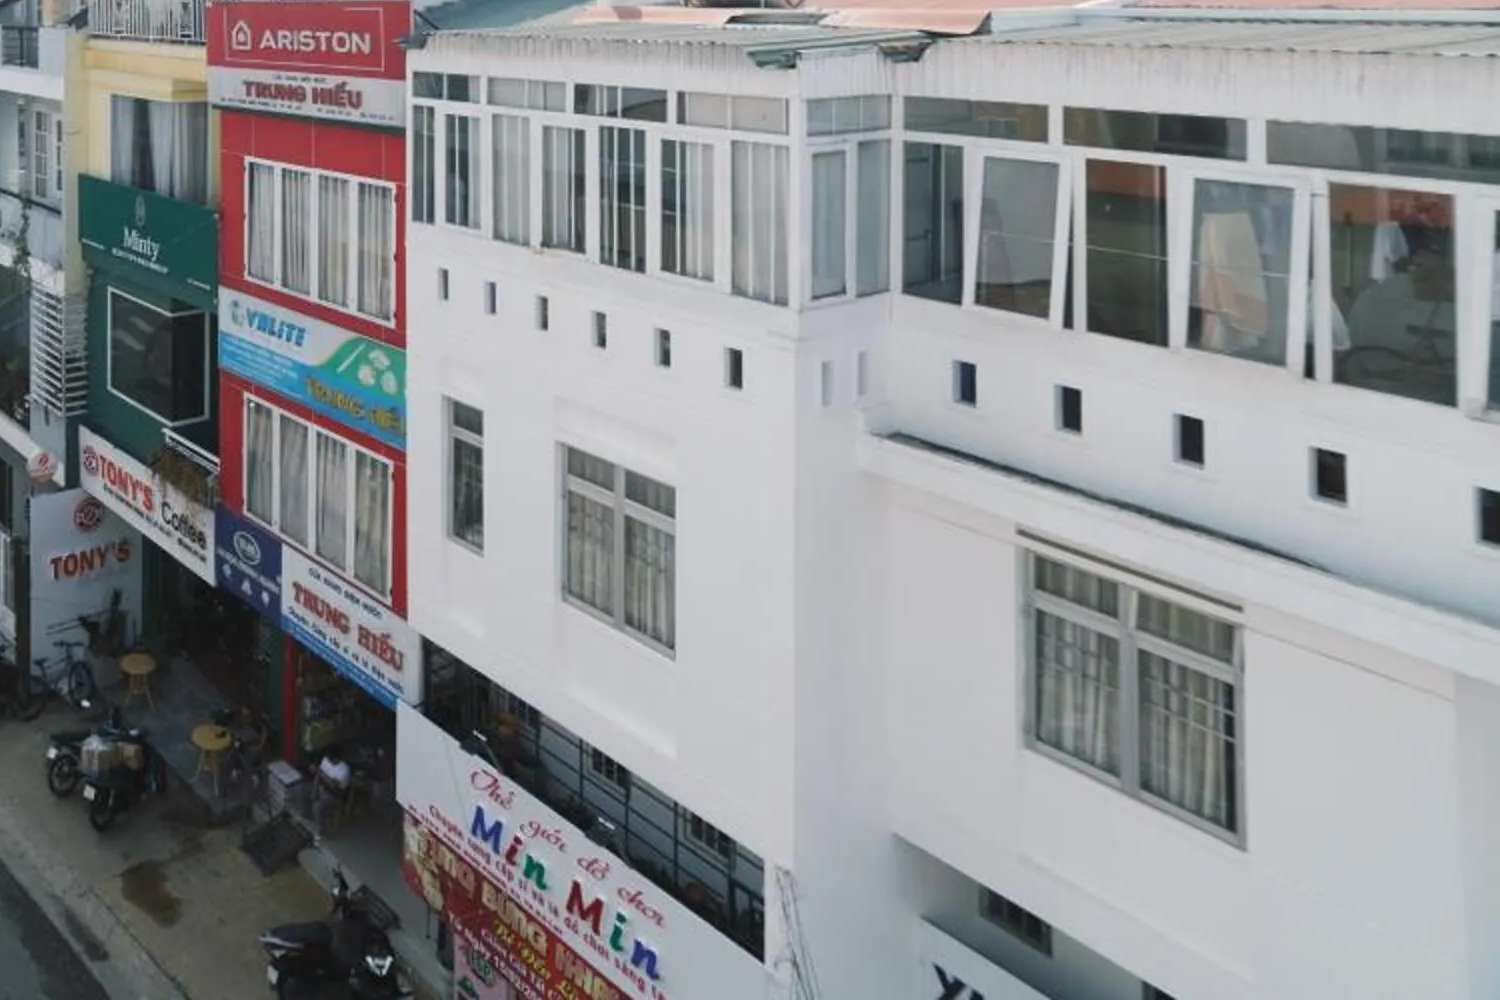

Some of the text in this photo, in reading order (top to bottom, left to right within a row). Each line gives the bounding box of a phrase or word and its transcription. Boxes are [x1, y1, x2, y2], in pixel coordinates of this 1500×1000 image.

[259, 28, 372, 55] ARISTON
[242, 79, 307, 102] TRUNG
[311, 80, 363, 110] HIẾU
[99, 454, 154, 512] TONY'S
[161, 501, 207, 550] Coffee
[50, 537, 130, 581] TONY'S
[292, 580, 349, 634] TRUNG
[357, 624, 405, 671] HIẾU
[471, 804, 548, 891] Min
[565, 878, 661, 982] Min
